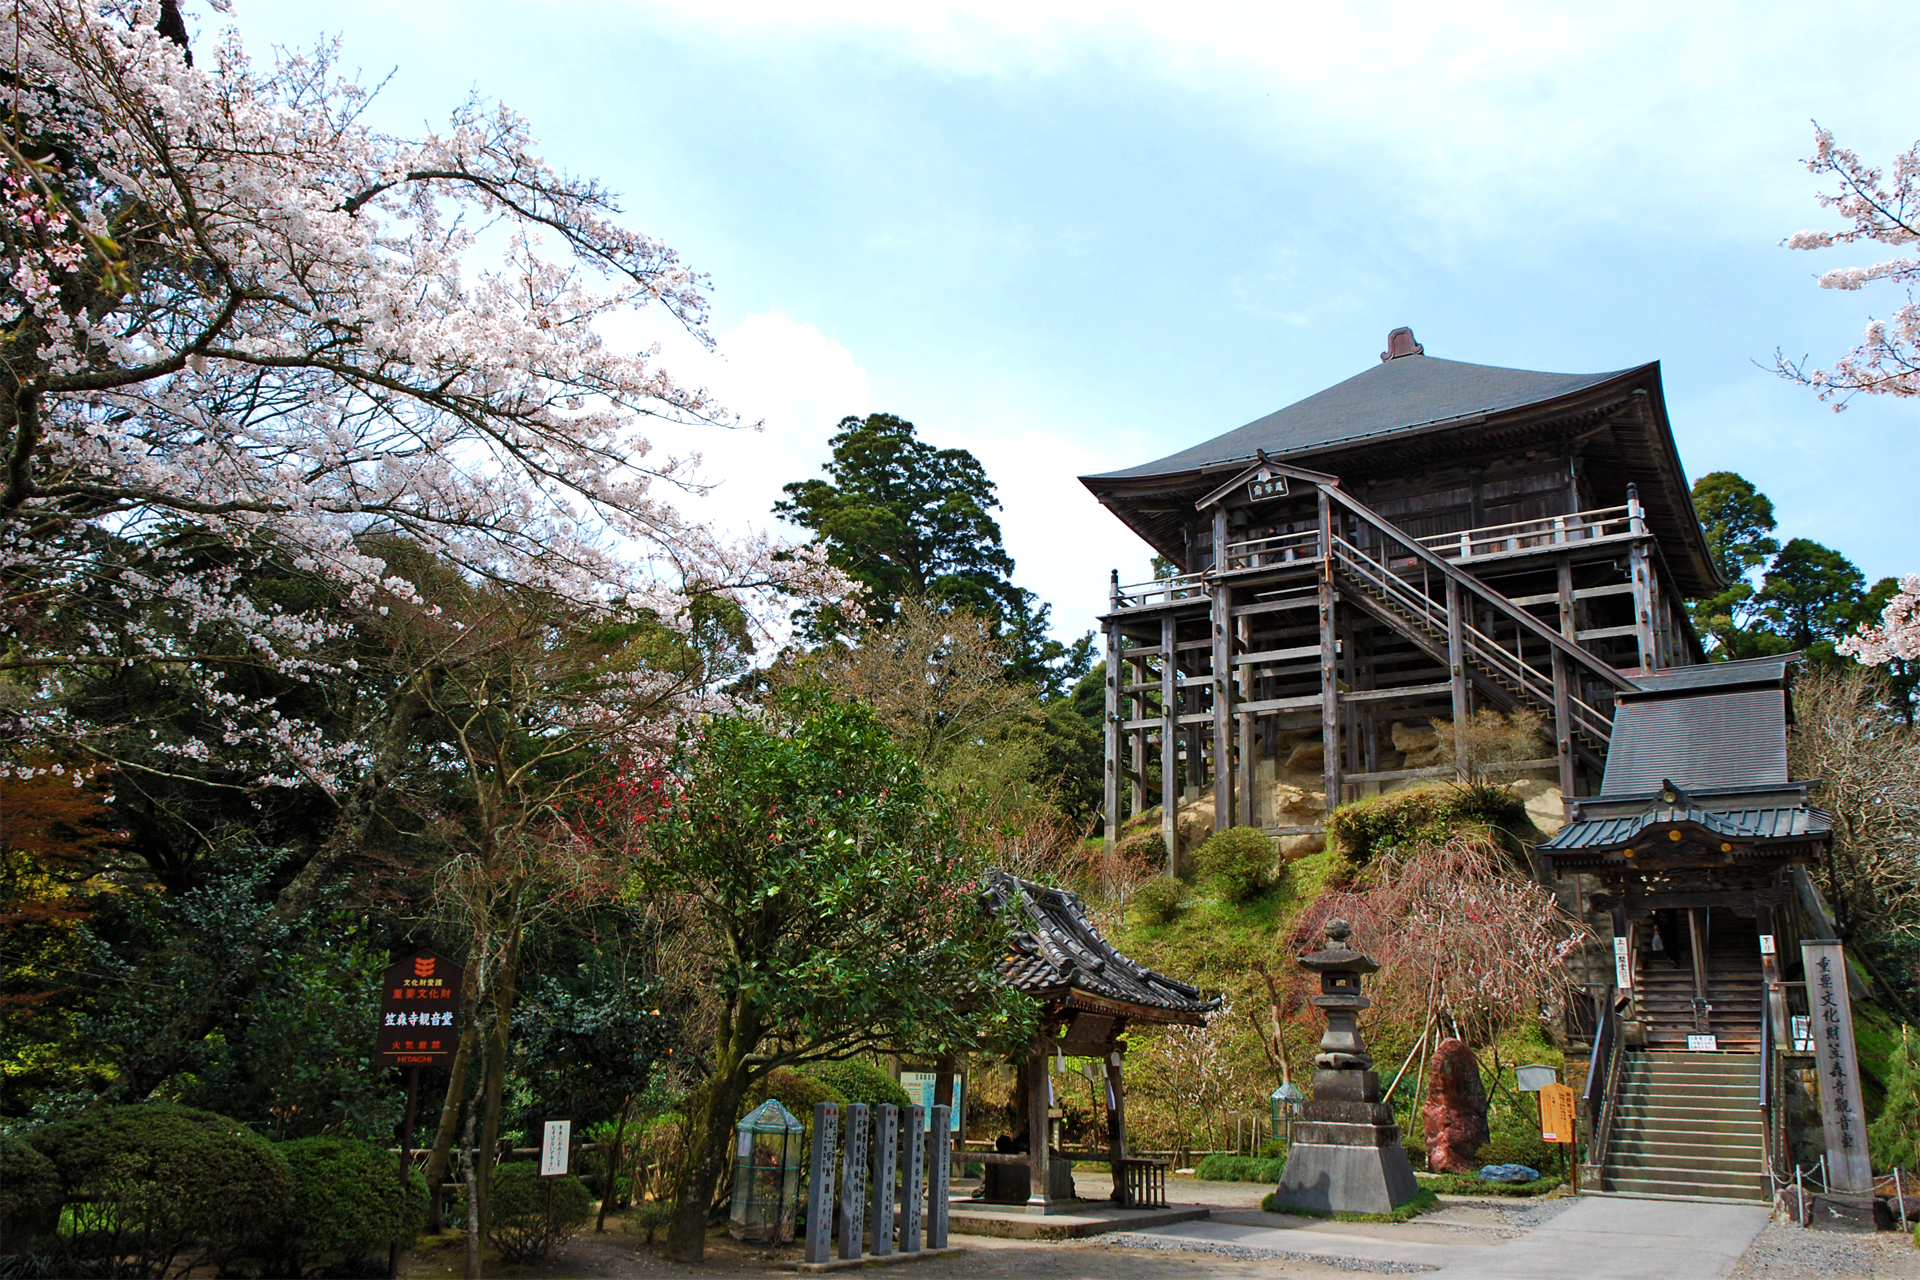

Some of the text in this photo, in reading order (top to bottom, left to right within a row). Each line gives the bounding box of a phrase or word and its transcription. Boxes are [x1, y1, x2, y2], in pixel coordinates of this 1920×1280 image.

[403, 979, 443, 987] 文化財愛護
[392, 988, 451, 999] 重要文化財
[384, 1011, 453, 1026] 笠森寺観音堂
